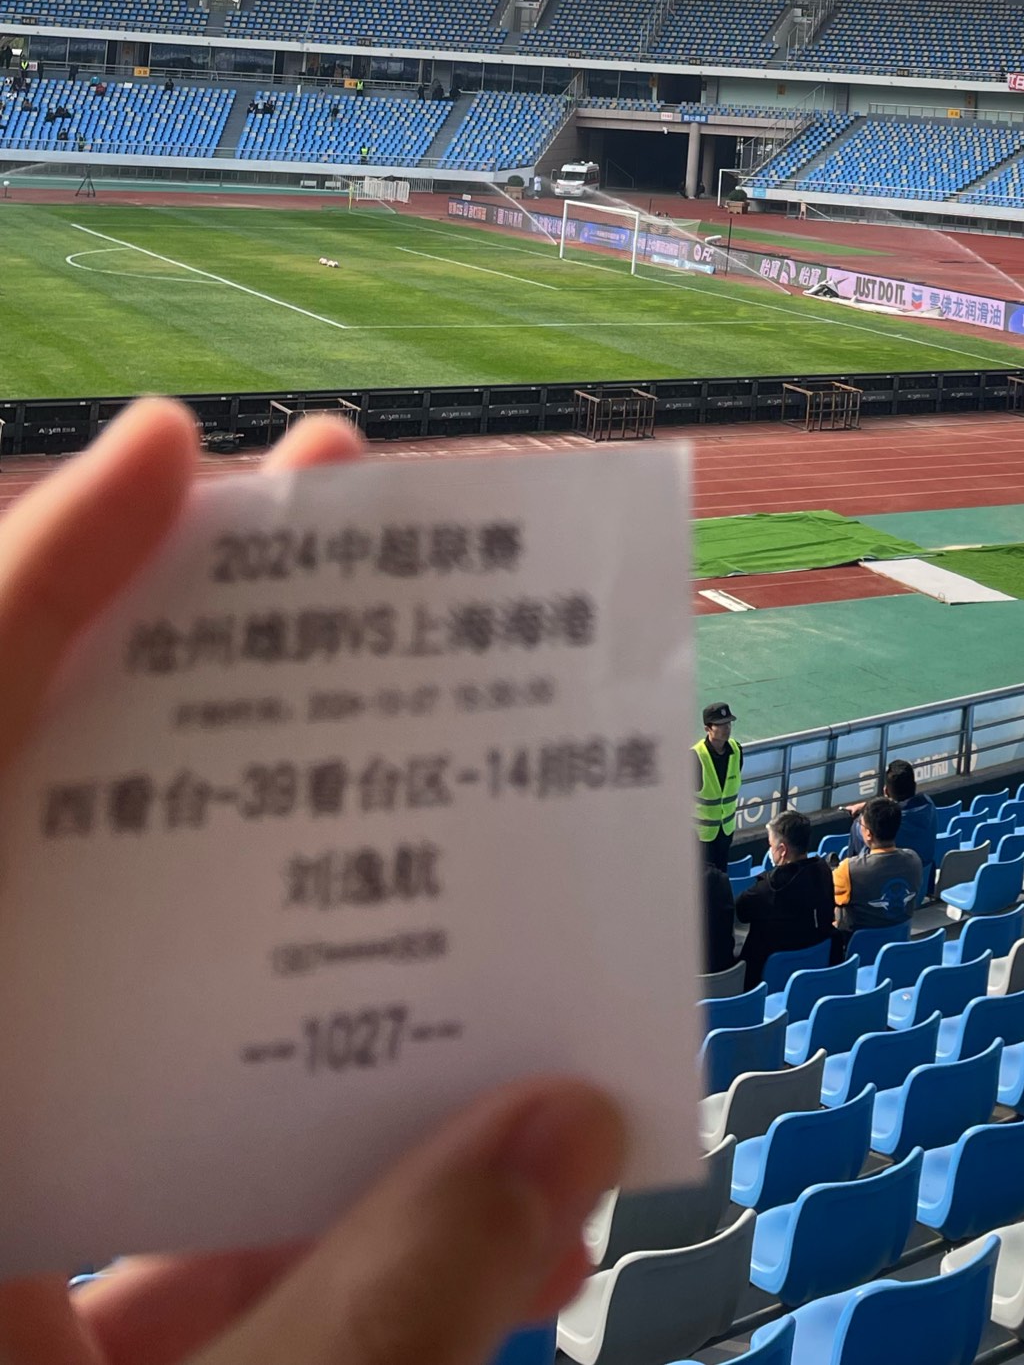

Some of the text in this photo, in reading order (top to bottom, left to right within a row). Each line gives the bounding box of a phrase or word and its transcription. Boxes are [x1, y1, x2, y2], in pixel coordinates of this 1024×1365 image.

[853, 276, 877, 299] JUST
[878, 281, 895, 303] DO
[211, 522, 525, 583] 2024中超联赛
